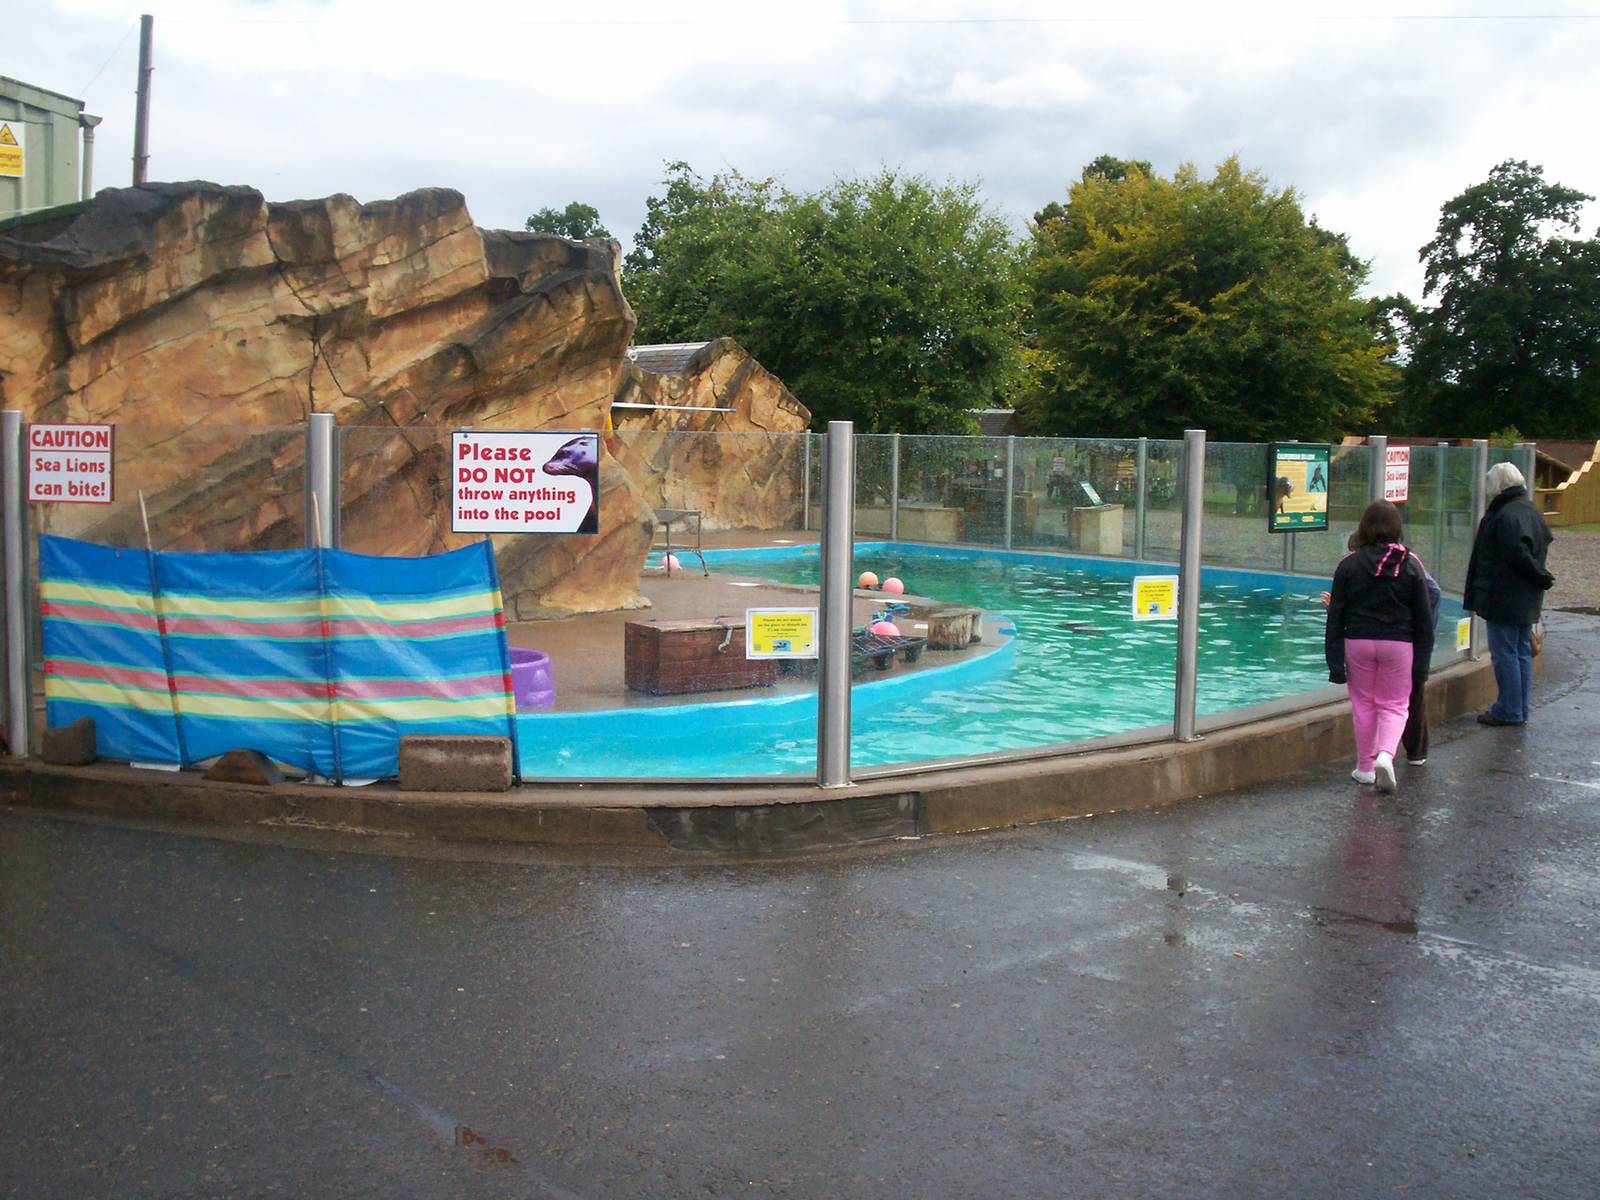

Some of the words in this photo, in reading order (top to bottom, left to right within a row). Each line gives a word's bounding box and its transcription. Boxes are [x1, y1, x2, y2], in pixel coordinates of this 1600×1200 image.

[32, 430, 109, 447] CAUTION
[458, 443, 532, 461] Please
[1386, 450, 1409, 462] CAUTION
[35, 458, 61, 472] Sea
[66, 458, 105, 473] Lions
[458, 467, 488, 483] DO
[495, 468, 535, 483] NOT
[35, 484, 62, 495] can
[68, 480, 105, 496] bite!
[458, 487, 504, 501] throw
[509, 487, 576, 504] anything
[458, 506, 490, 520] into
[495, 507, 519, 520] the
[525, 507, 561, 523] pool
